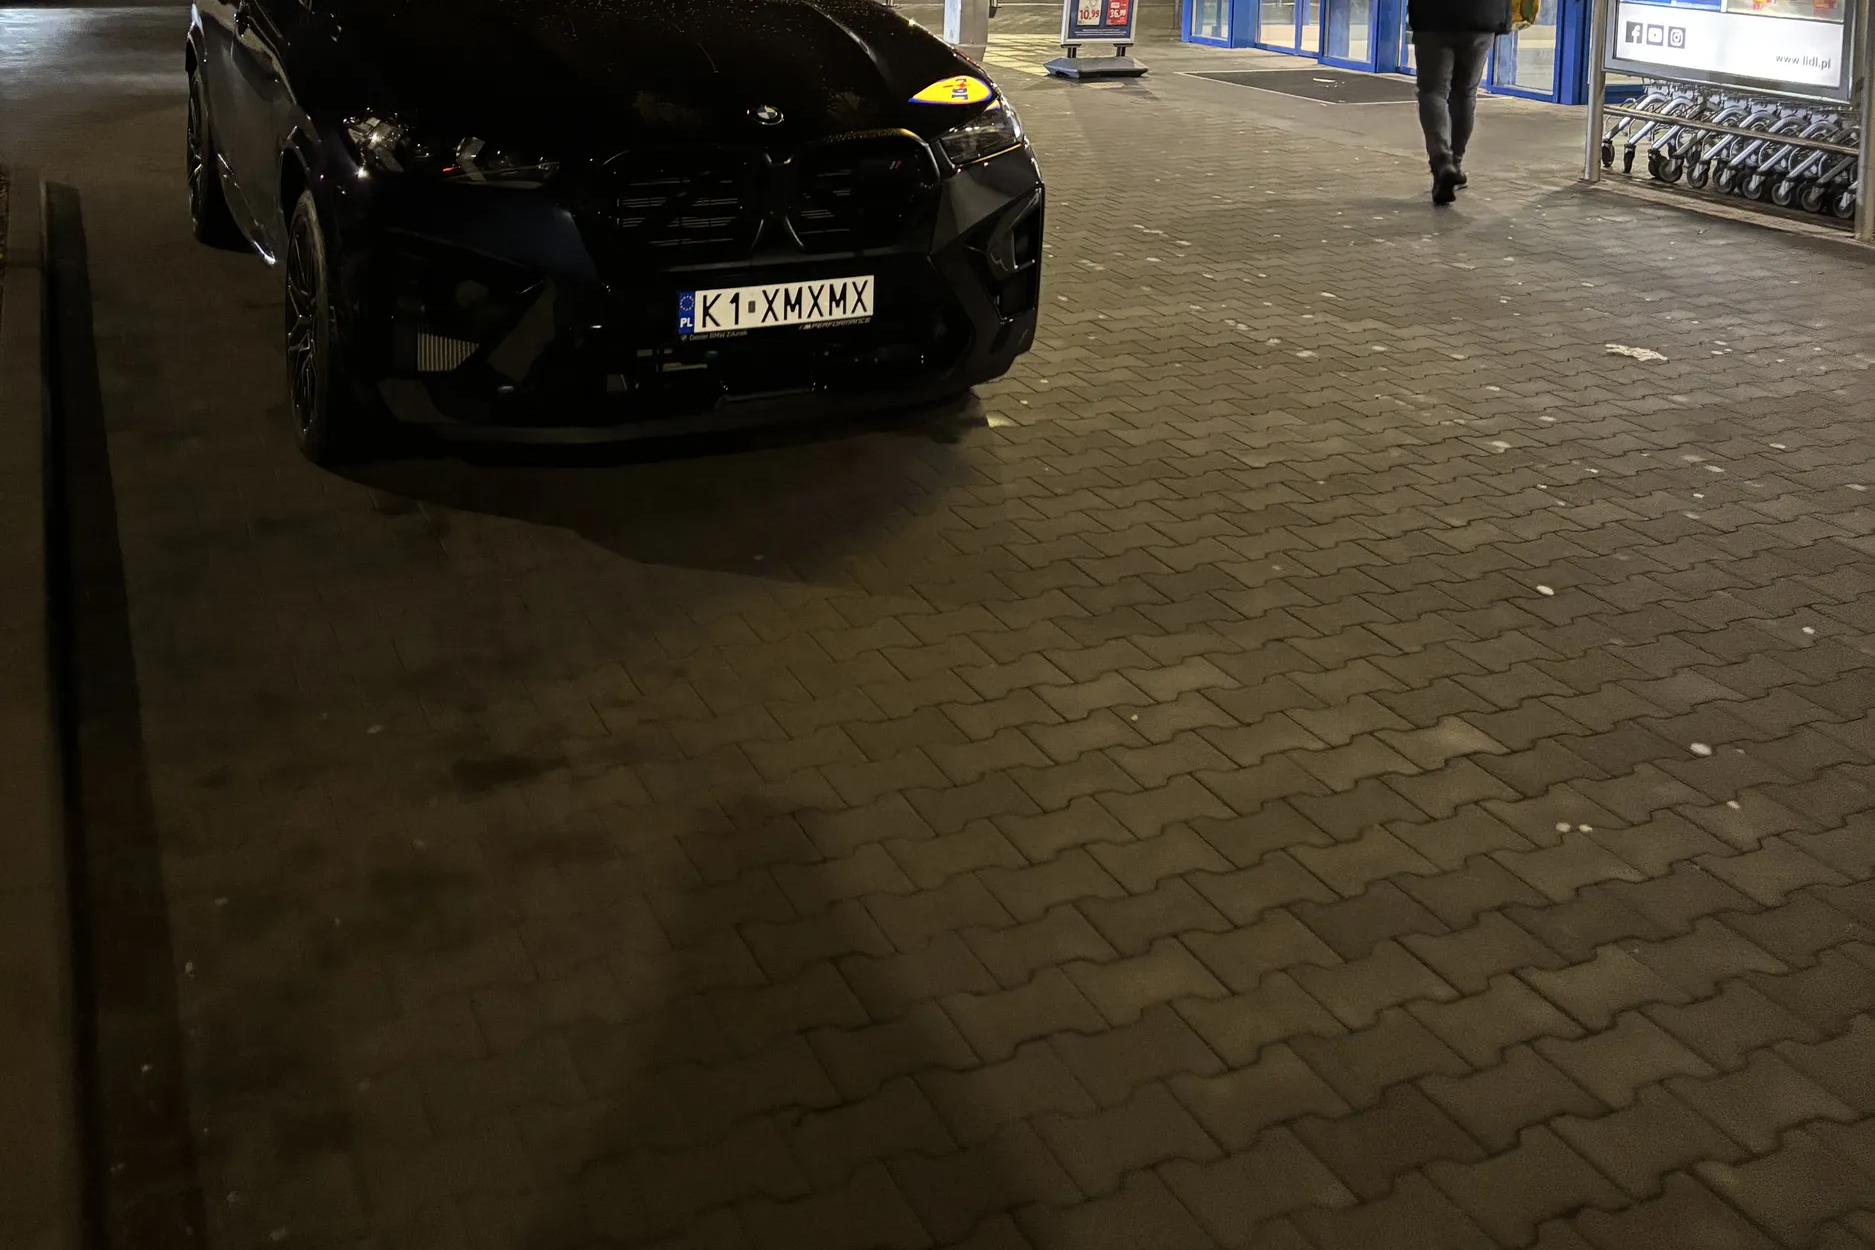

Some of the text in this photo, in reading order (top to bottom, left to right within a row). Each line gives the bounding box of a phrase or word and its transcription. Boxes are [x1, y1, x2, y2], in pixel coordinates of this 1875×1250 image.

[1079, 9, 1100, 20] 10.99
[702, 279, 869, 328] K1 XMXMX
[679, 317, 693, 328] PL
